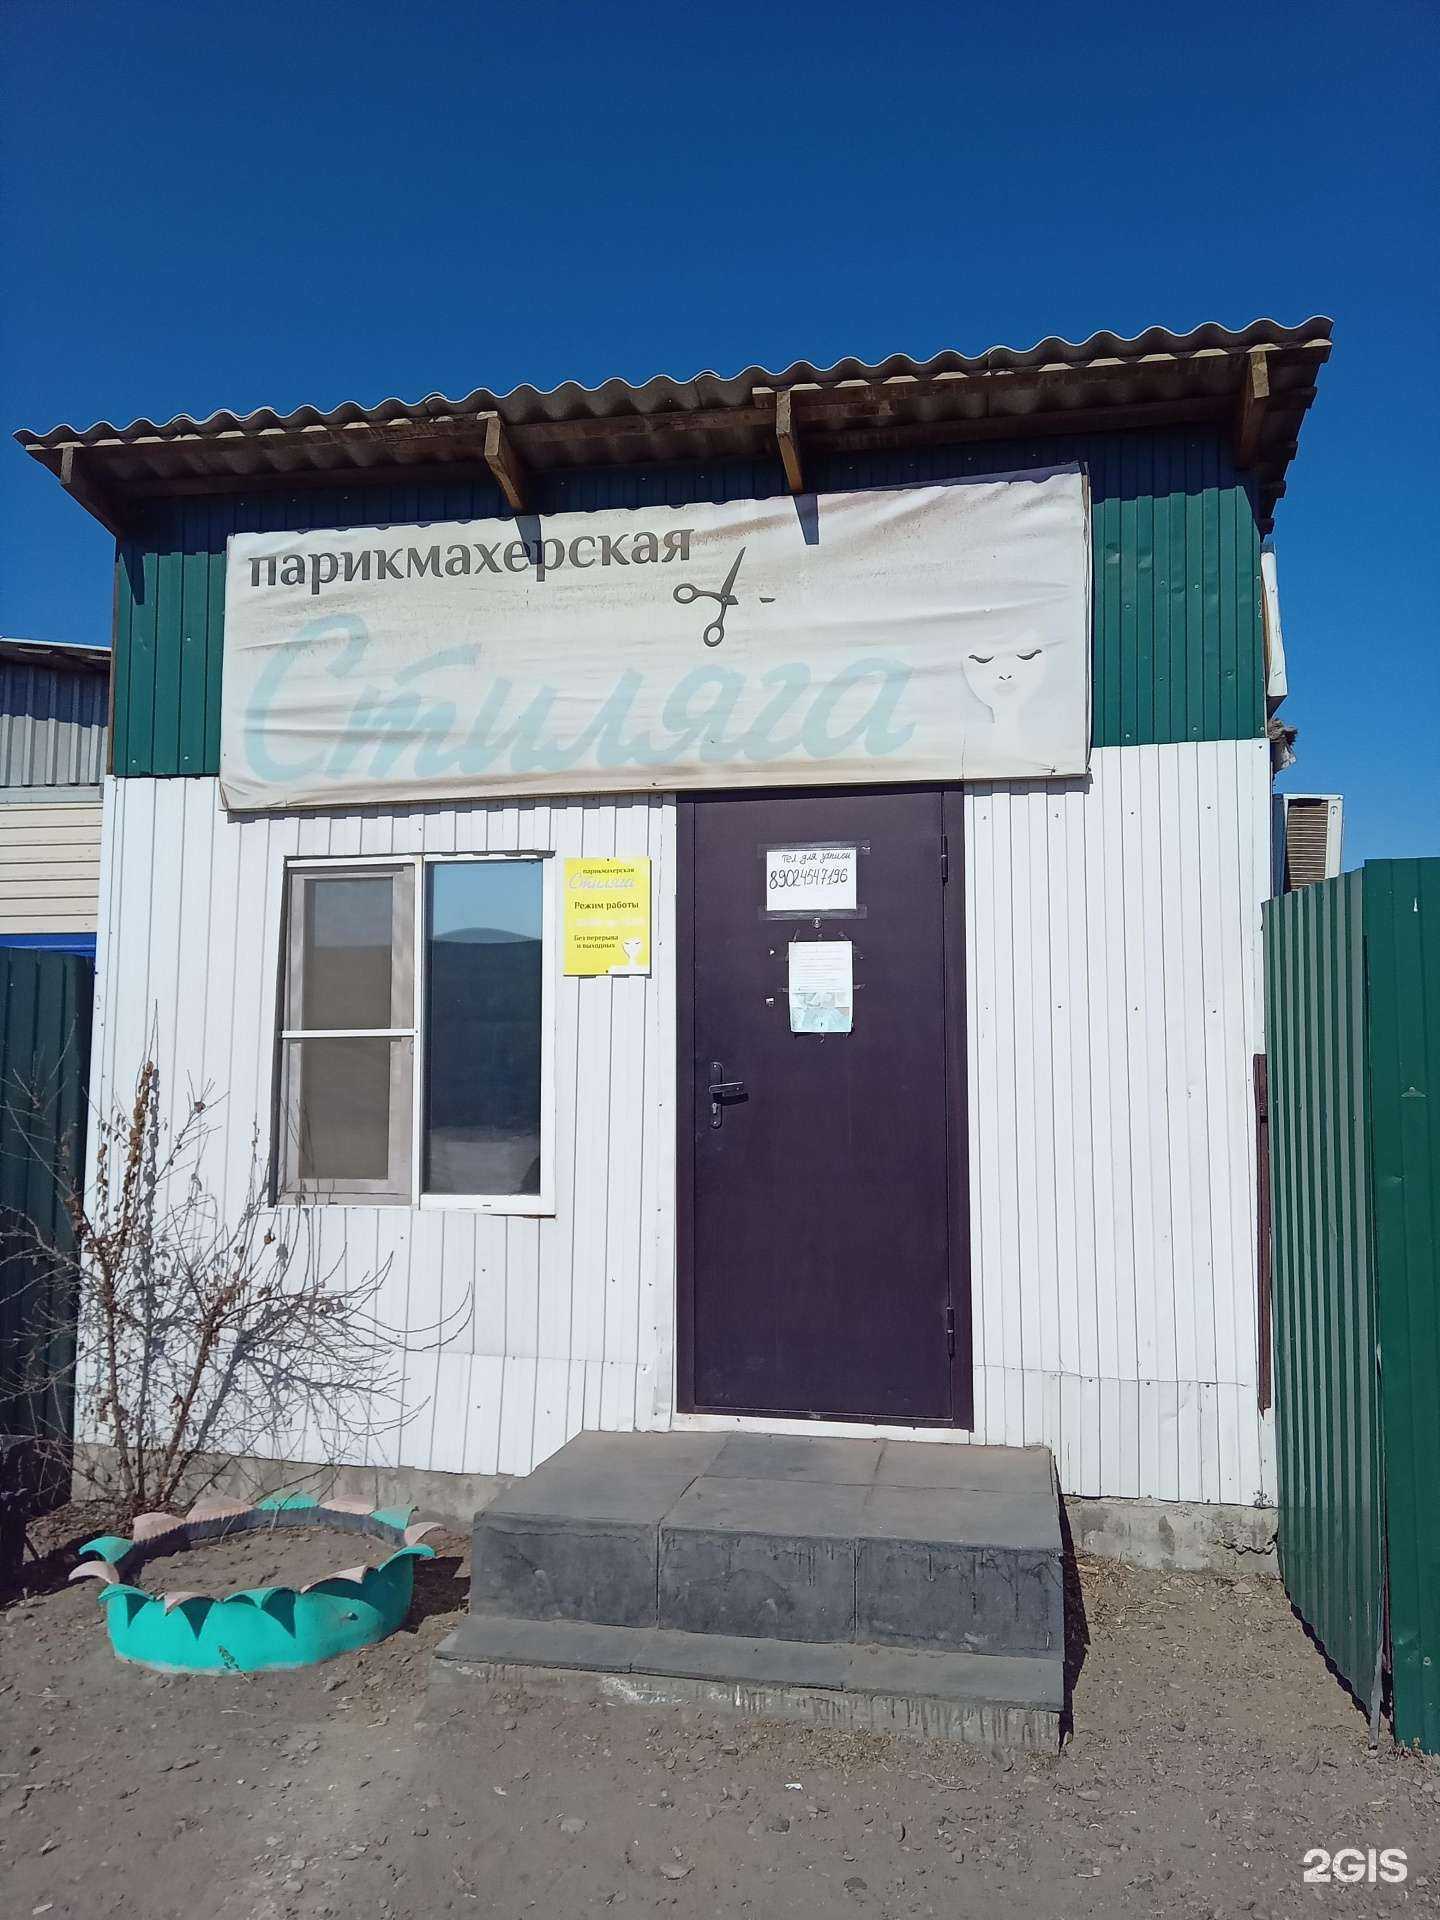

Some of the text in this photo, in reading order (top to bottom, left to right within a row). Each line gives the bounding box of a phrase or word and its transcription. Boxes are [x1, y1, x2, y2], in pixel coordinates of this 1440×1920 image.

[248, 528, 694, 595] парикмахерская
[244, 611, 916, 783] Стиляга
[799, 853, 817, 864] для
[574, 900, 639, 911] Режим работы
